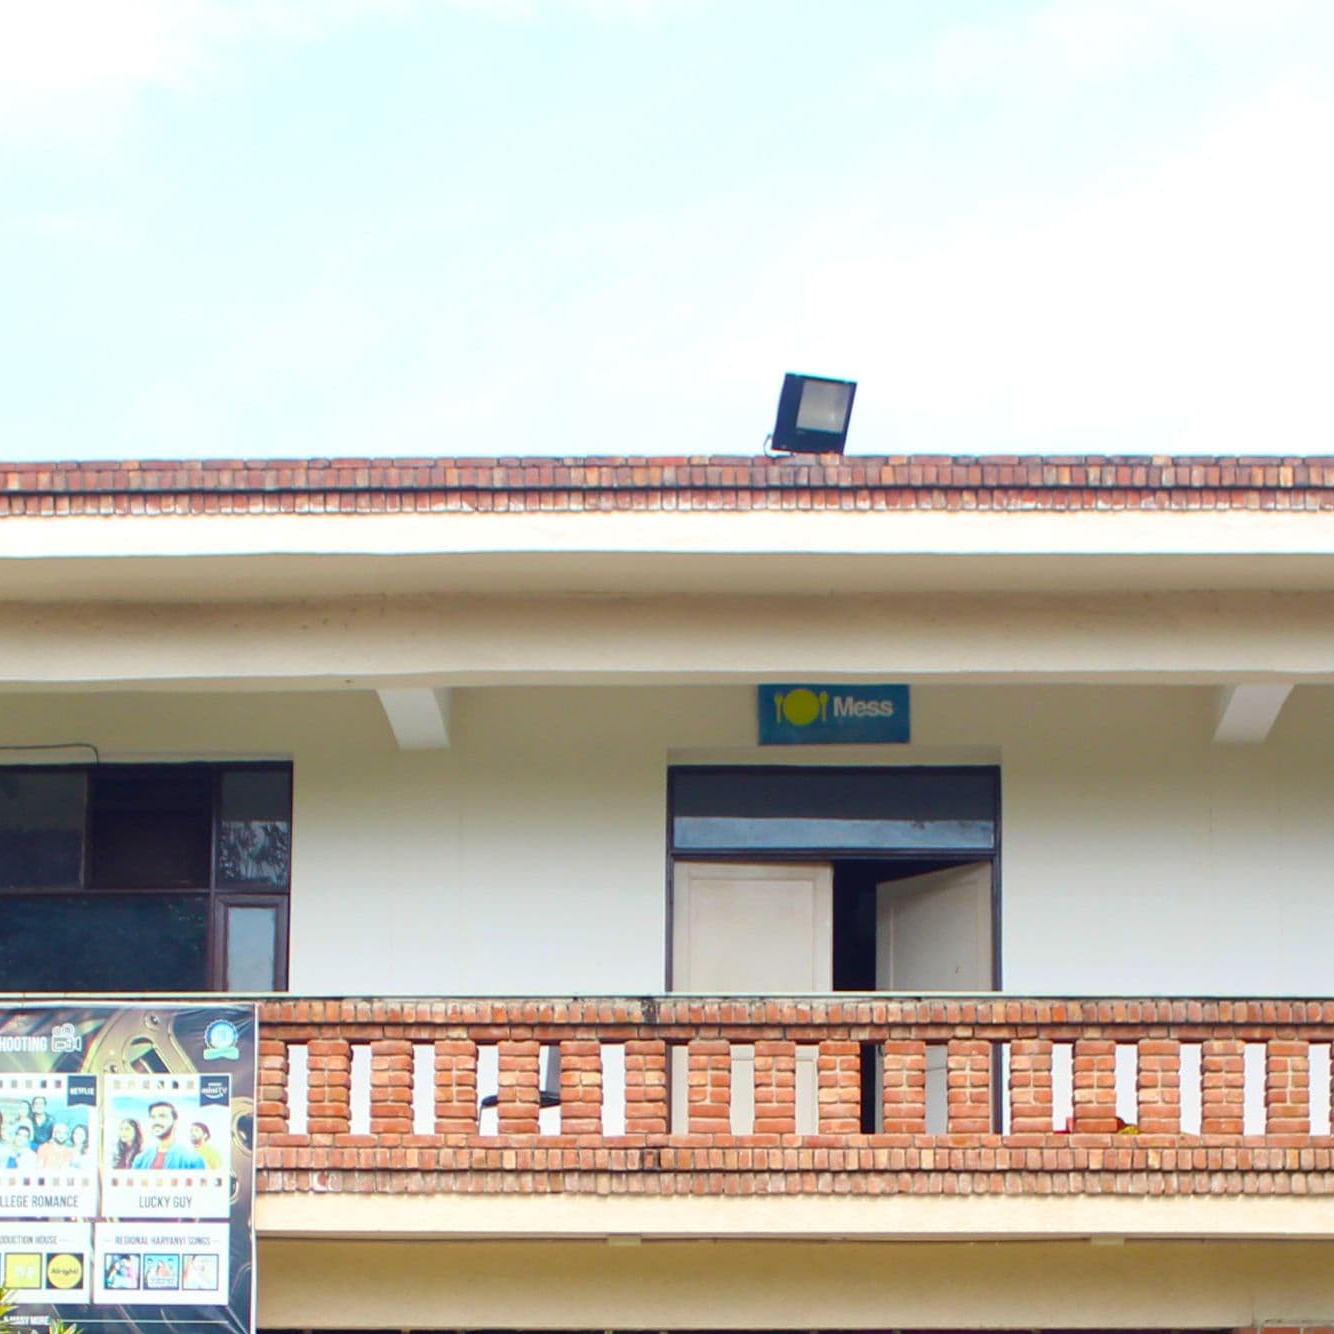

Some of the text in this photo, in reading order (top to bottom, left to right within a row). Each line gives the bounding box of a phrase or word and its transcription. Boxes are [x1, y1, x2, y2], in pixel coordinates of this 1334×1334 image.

[833, 696, 894, 717] Mess
[32, 1195, 79, 1208] ROMANCE
[139, 1196, 192, 1208] LUCKY GUY
